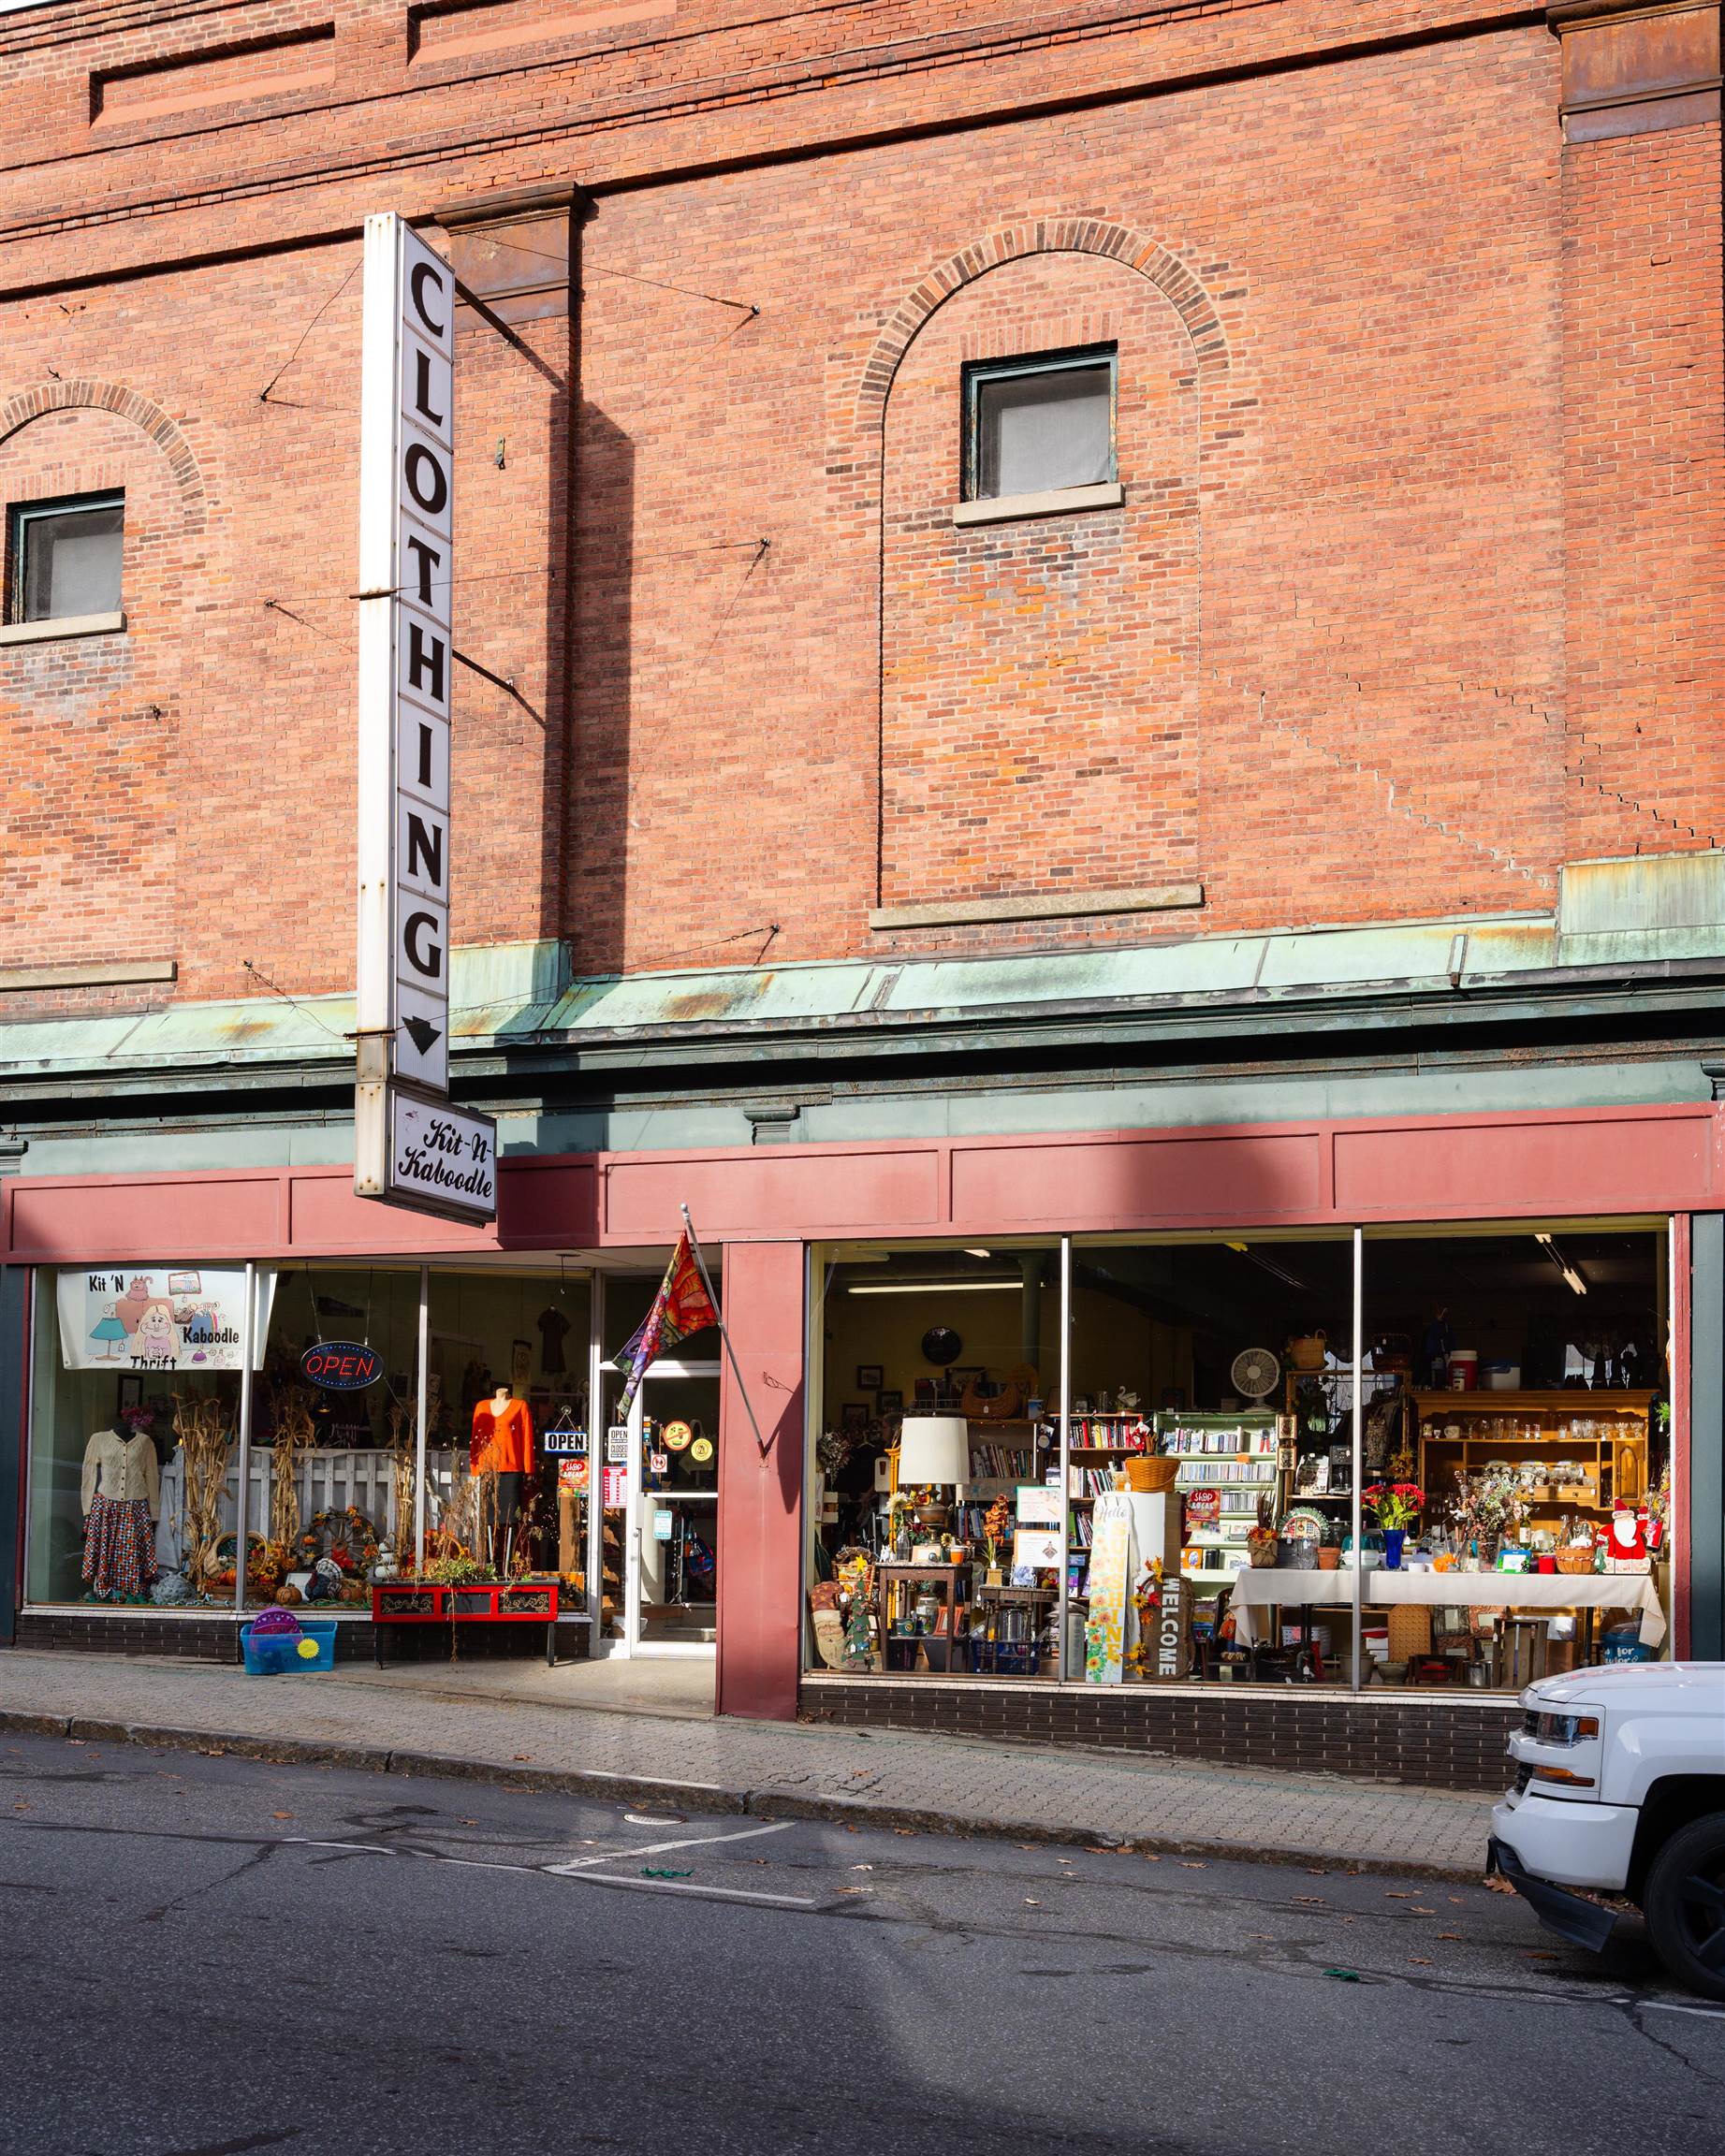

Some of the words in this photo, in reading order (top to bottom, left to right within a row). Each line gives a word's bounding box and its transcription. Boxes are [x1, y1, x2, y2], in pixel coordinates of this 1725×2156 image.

[403, 261, 448, 980] CLOTHING
[398, 1145, 492, 1199] Kaboodle
[89, 1275, 107, 1292] Kit
[183, 1326, 240, 1344] Kaboodle
[130, 1355, 178, 1370] Thrift
[306, 1355, 374, 1377] OPEN
[548, 1434, 584, 1450] OPEN
[610, 1429, 628, 1439] OPEN
[1094, 1505, 1128, 1522] Hello
[1104, 1521, 1130, 1662] SUNSHINE
[1159, 1578, 1180, 1676] WELCOME
